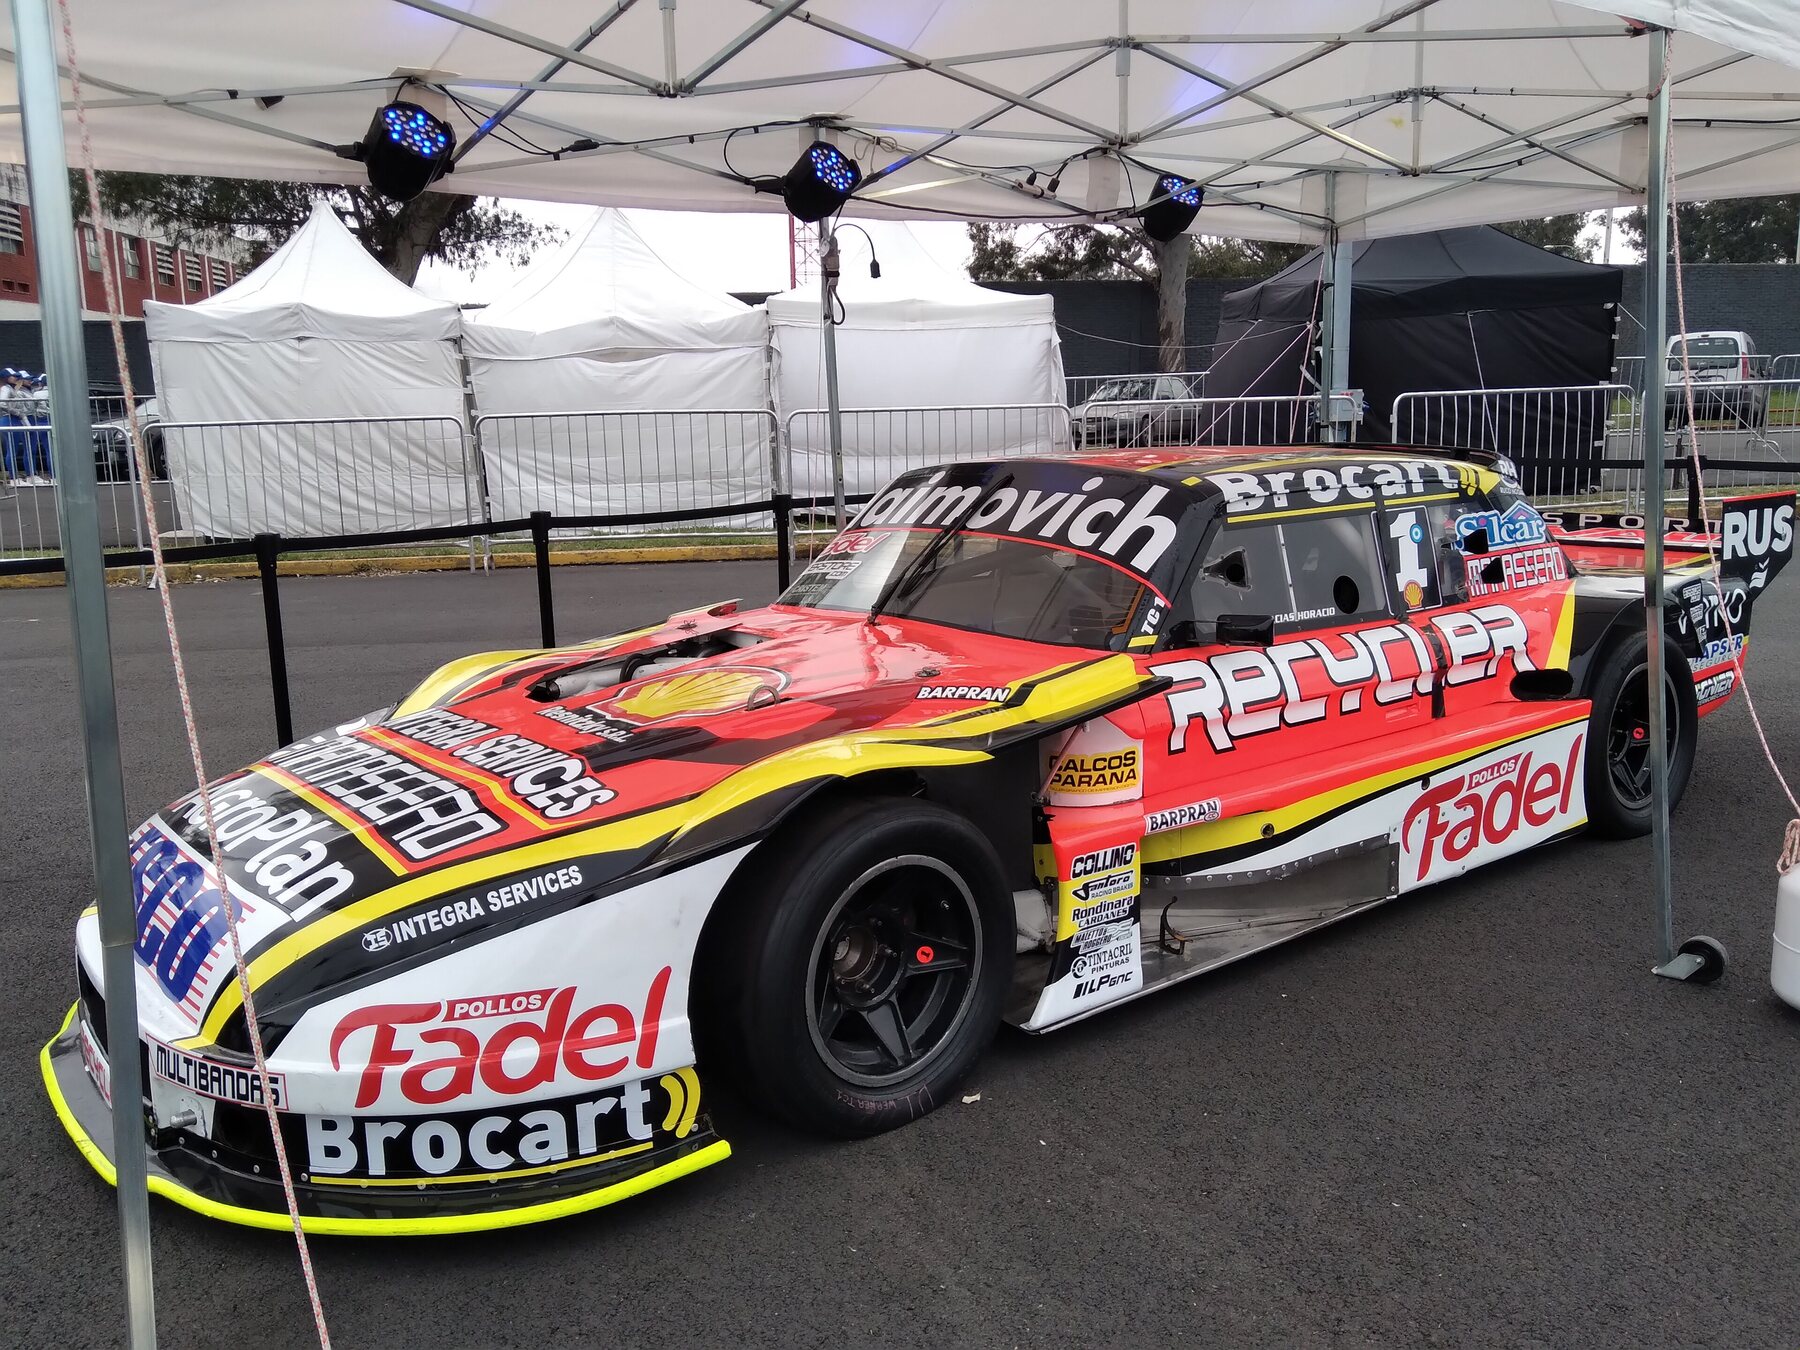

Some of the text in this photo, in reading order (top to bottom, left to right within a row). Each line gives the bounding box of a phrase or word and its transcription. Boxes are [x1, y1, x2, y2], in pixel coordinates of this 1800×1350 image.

[1204, 462, 1462, 513] Brocart
[1723, 505, 1794, 560] RUS
[1389, 511, 1428, 592] 1
[1298, 607, 1336, 620] HORACIO
[916, 687, 1010, 702] BARPRAN
[453, 734, 617, 818] SERVICES
[1049, 769, 1137, 787] PARANA
[1472, 759, 1516, 787] POLLOS
[1150, 801, 1218, 831] BARPRAN
[1402, 733, 1583, 881] Fadel
[1072, 844, 1136, 878] COLLINO
[1072, 870, 1134, 900] Santoro
[1091, 882, 1134, 899] RACING BRAKES
[392, 898, 485, 943] INTEGRA
[486, 865, 583, 912] SERVICES
[1072, 896, 1133, 921] Rondinara
[1079, 908, 1128, 928] CARDANES
[1087, 943, 1133, 967] TINTACRIL
[1091, 957, 1130, 974] PINTURAS
[452, 993, 543, 1019] POLLOS
[329, 966, 673, 1109] Fadel
[156, 1045, 280, 1106] MULTIBANDAS
[306, 1081, 653, 1176] Brocart
